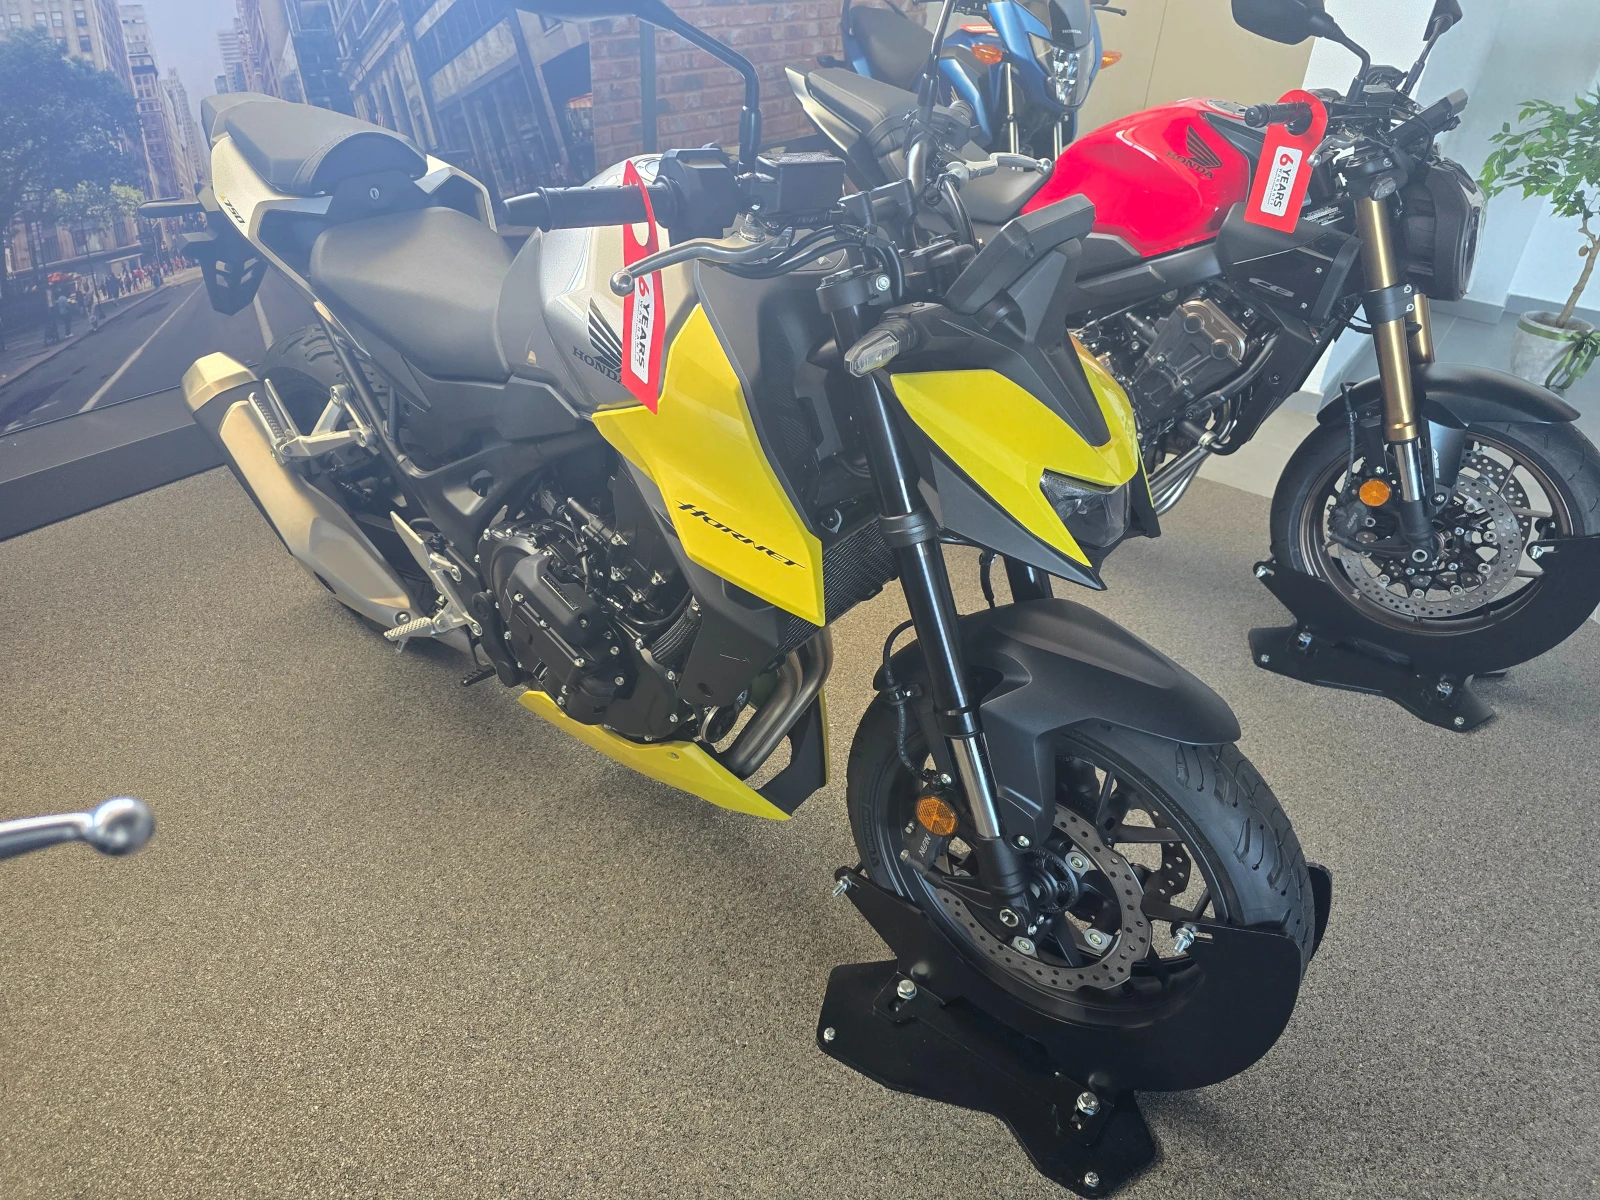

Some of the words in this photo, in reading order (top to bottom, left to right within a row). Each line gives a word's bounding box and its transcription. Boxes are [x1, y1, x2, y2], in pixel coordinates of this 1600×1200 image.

[1165, 150, 1214, 181] HONDA
[1279, 153, 1294, 167] 6
[1273, 168, 1292, 208] YEARS
[224, 199, 246, 224] 750
[638, 275, 650, 297] 6
[638, 302, 651, 369] YEARS
[675, 499, 807, 569] HORNET
[918, 832, 932, 858] NISSIN
